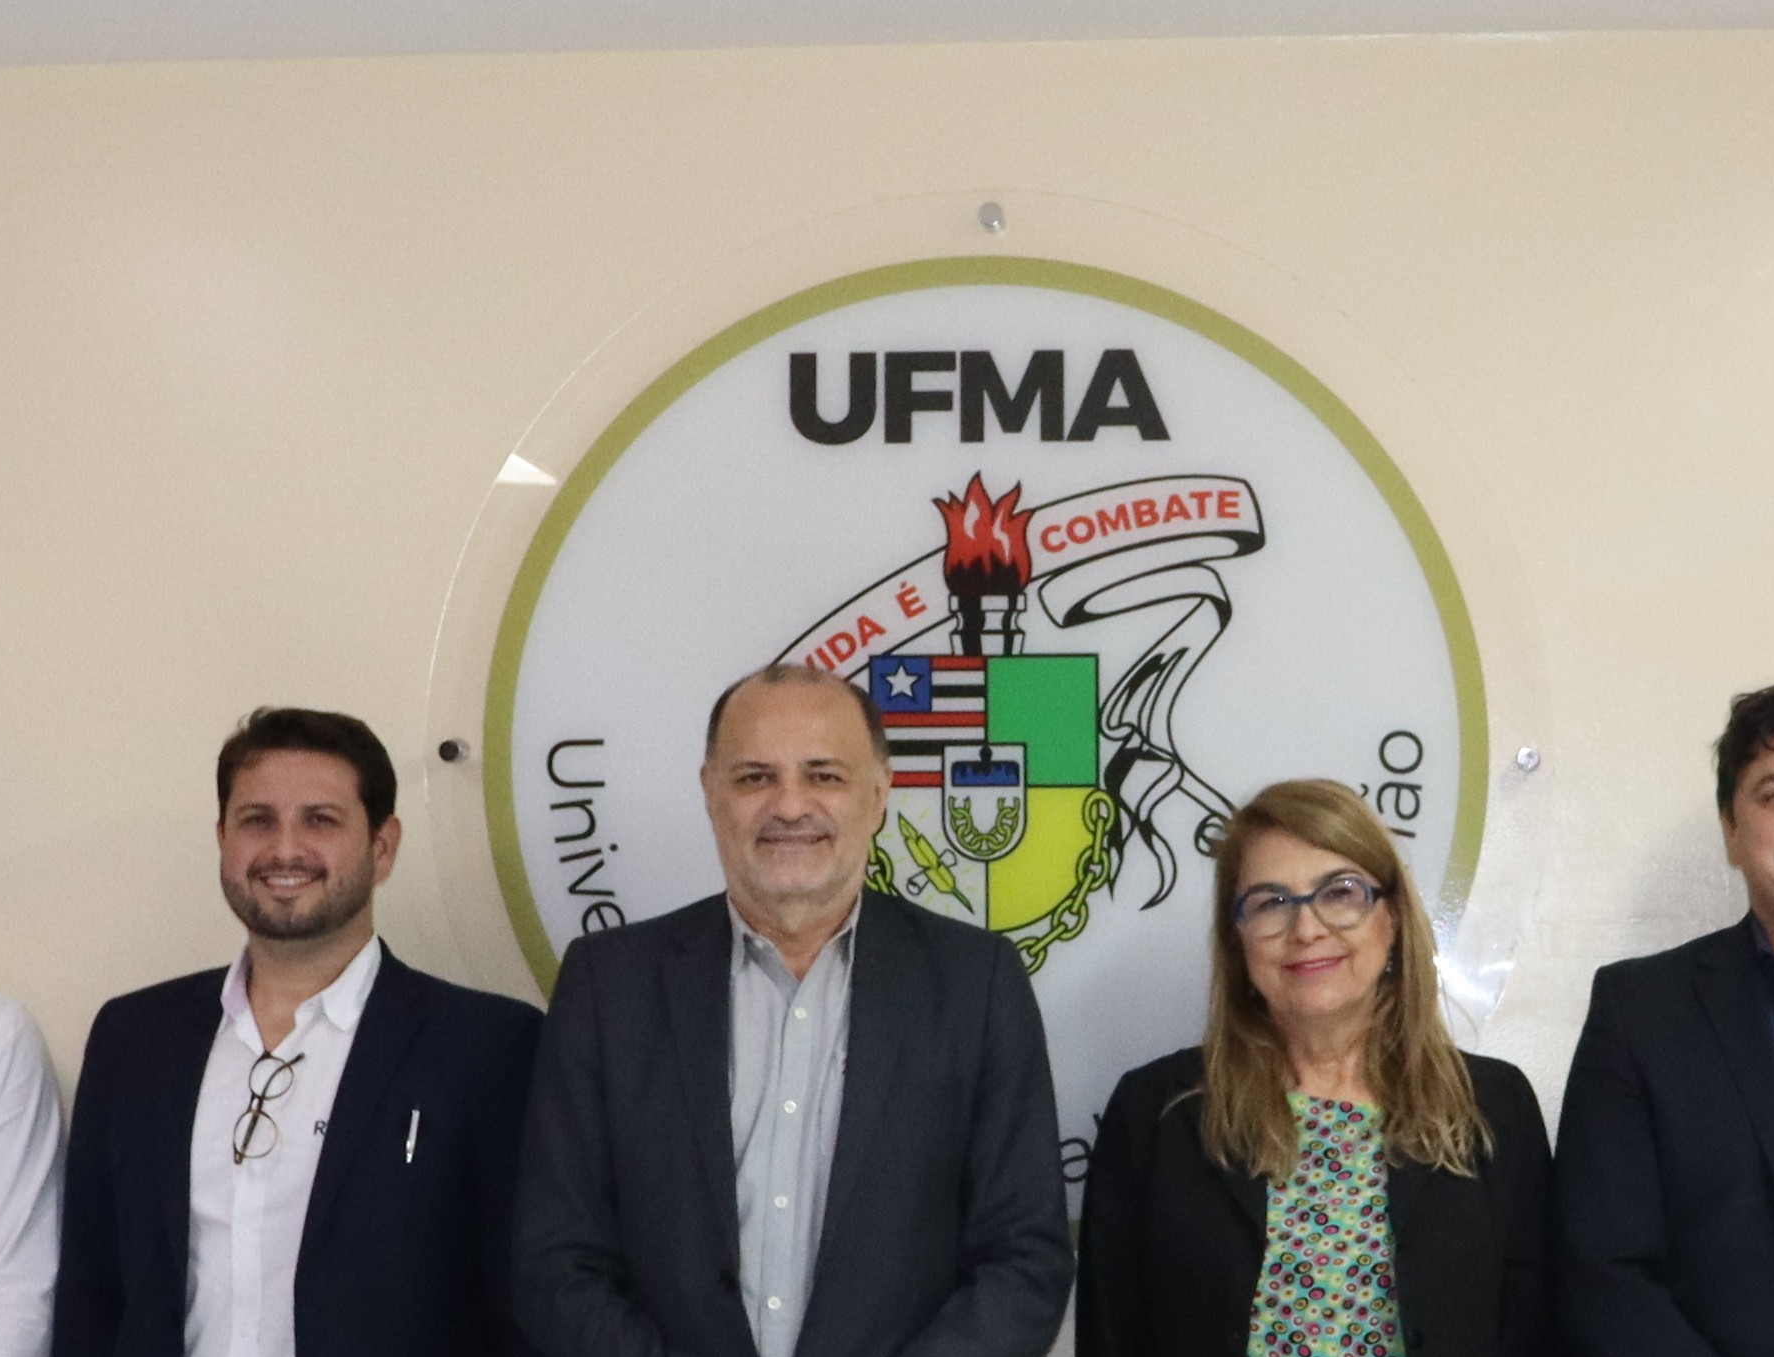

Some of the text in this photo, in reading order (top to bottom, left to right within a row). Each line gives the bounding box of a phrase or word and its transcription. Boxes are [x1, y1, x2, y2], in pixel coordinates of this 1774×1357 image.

[789, 348, 1171, 445] UFMA
[895, 581, 927, 619] É
[1039, 490, 1241, 554] COMBATE
